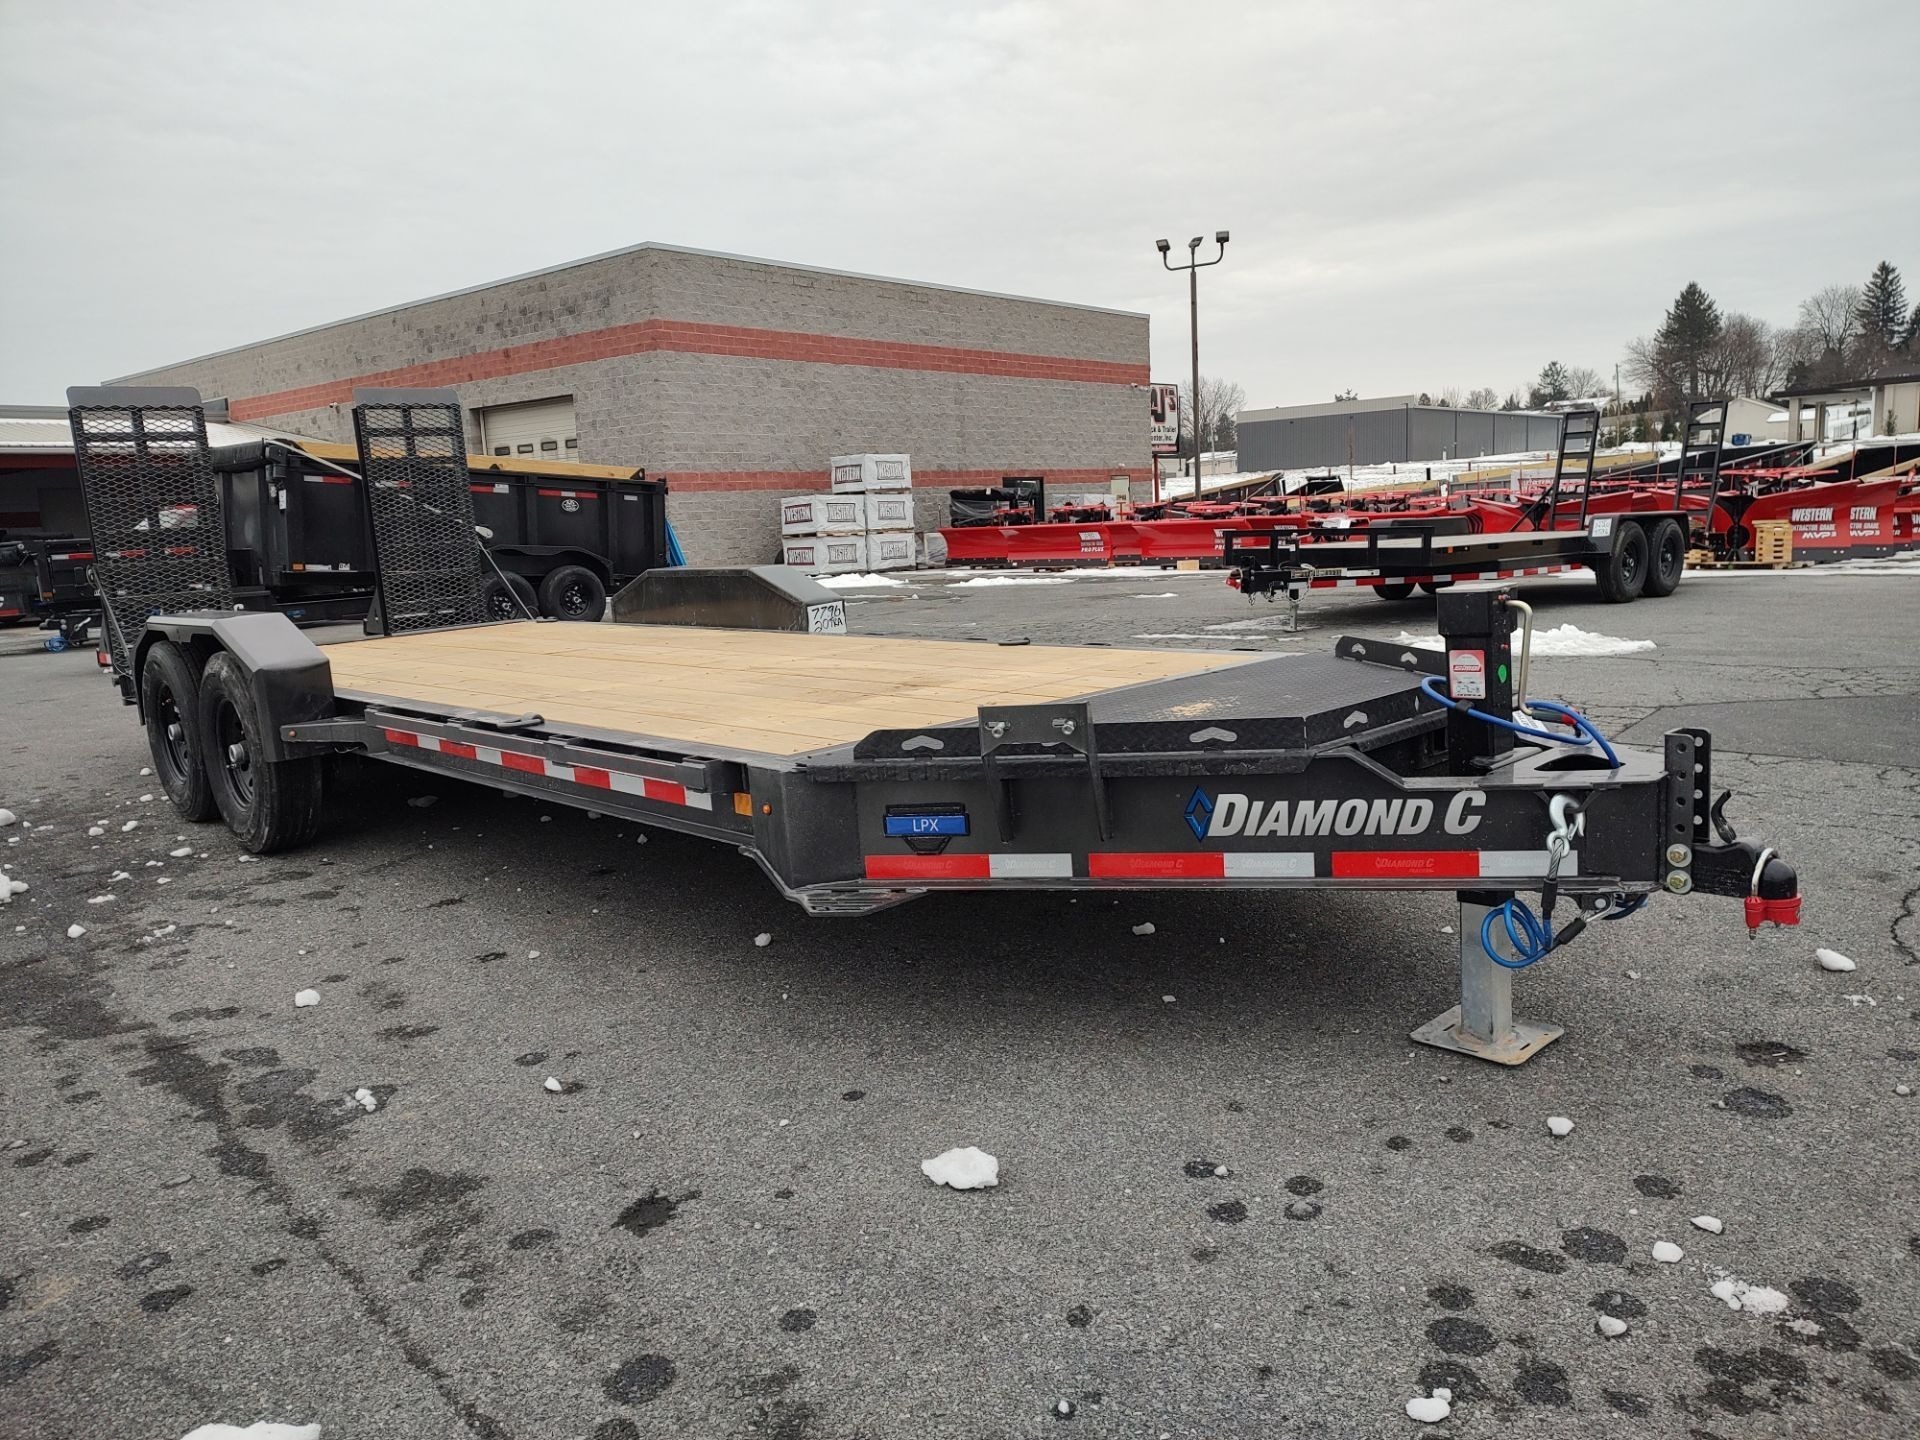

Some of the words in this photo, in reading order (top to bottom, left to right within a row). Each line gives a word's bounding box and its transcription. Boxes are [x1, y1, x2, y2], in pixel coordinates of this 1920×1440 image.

[1791, 507, 1834, 522] WESTERN
[1850, 506, 1877, 520] STERN
[1819, 523, 1836, 531] GRADE
[811, 605, 841, 620] 7796
[1207, 793, 1434, 837] DIAMOND
[1444, 790, 1487, 835] C
[913, 818, 939, 832] LPX
